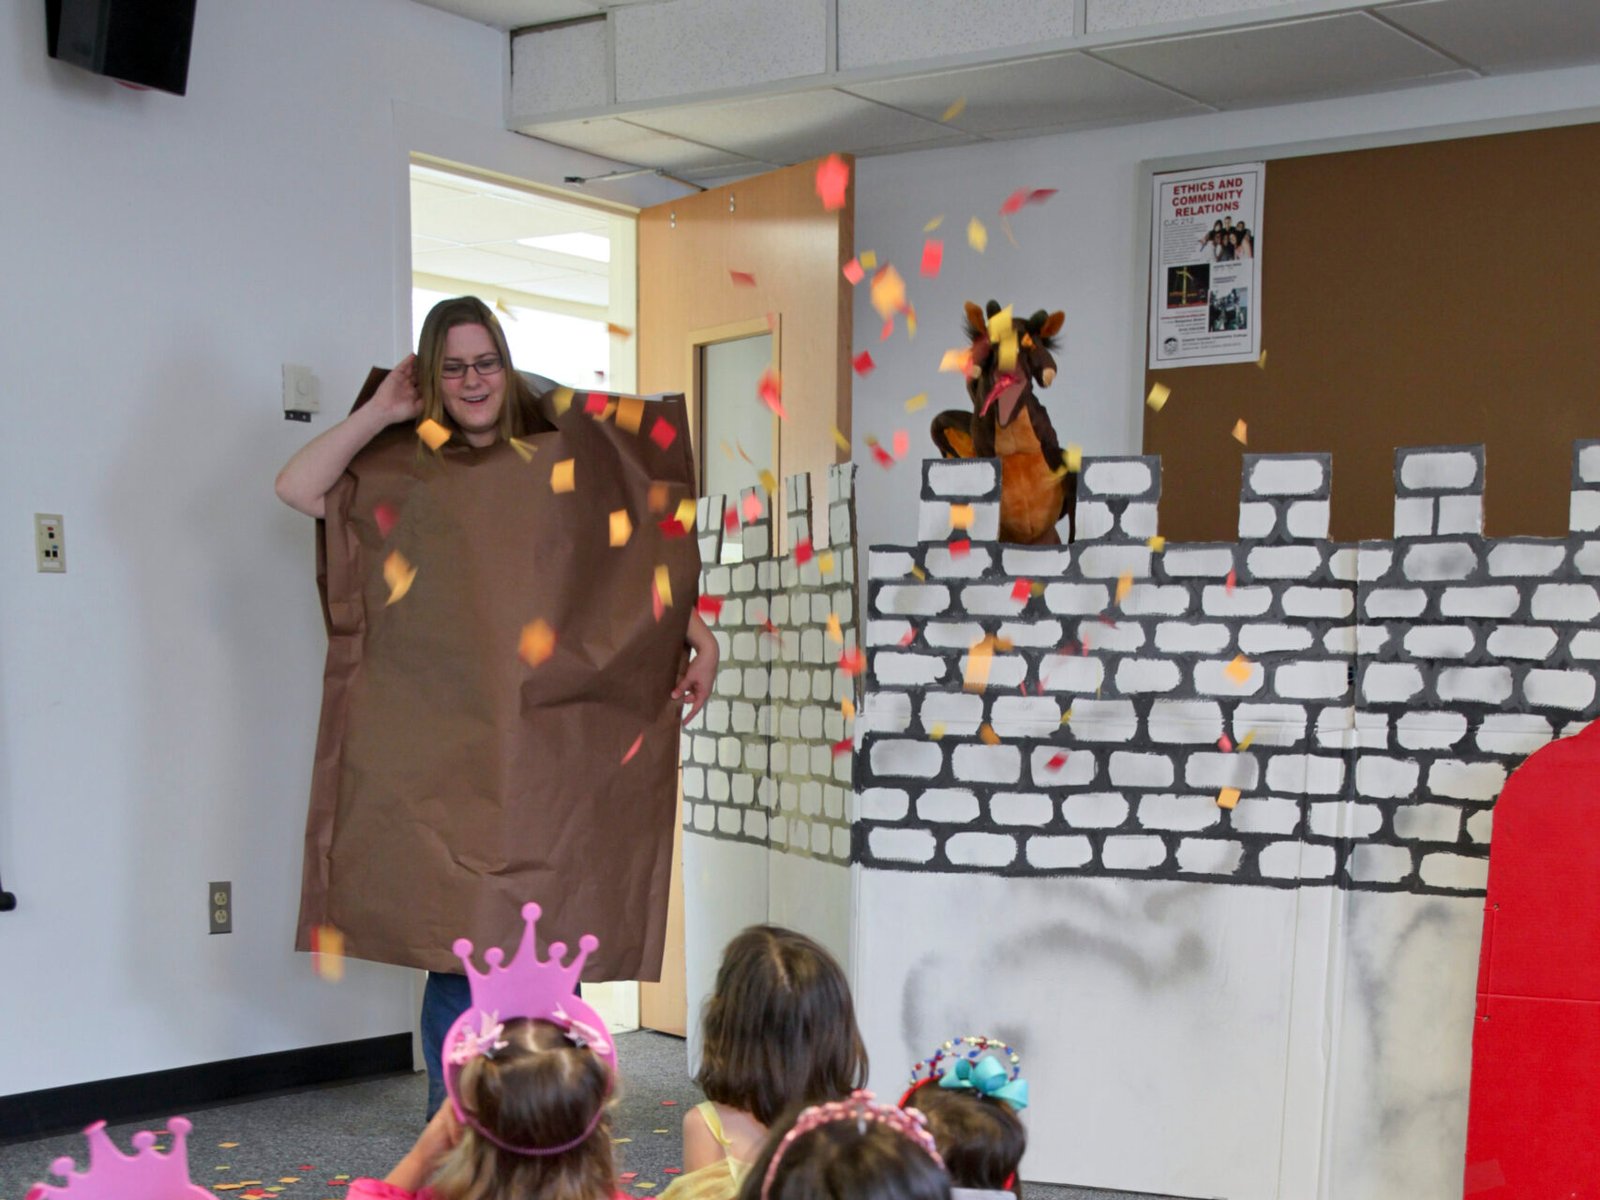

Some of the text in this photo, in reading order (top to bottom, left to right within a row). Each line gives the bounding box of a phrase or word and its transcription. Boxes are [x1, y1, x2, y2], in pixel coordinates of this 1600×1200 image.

[1173, 177, 1243, 196] ETHICS AND
[1172, 189, 1243, 207] COMMUNITY
[1175, 201, 1240, 217] RELATIONS
